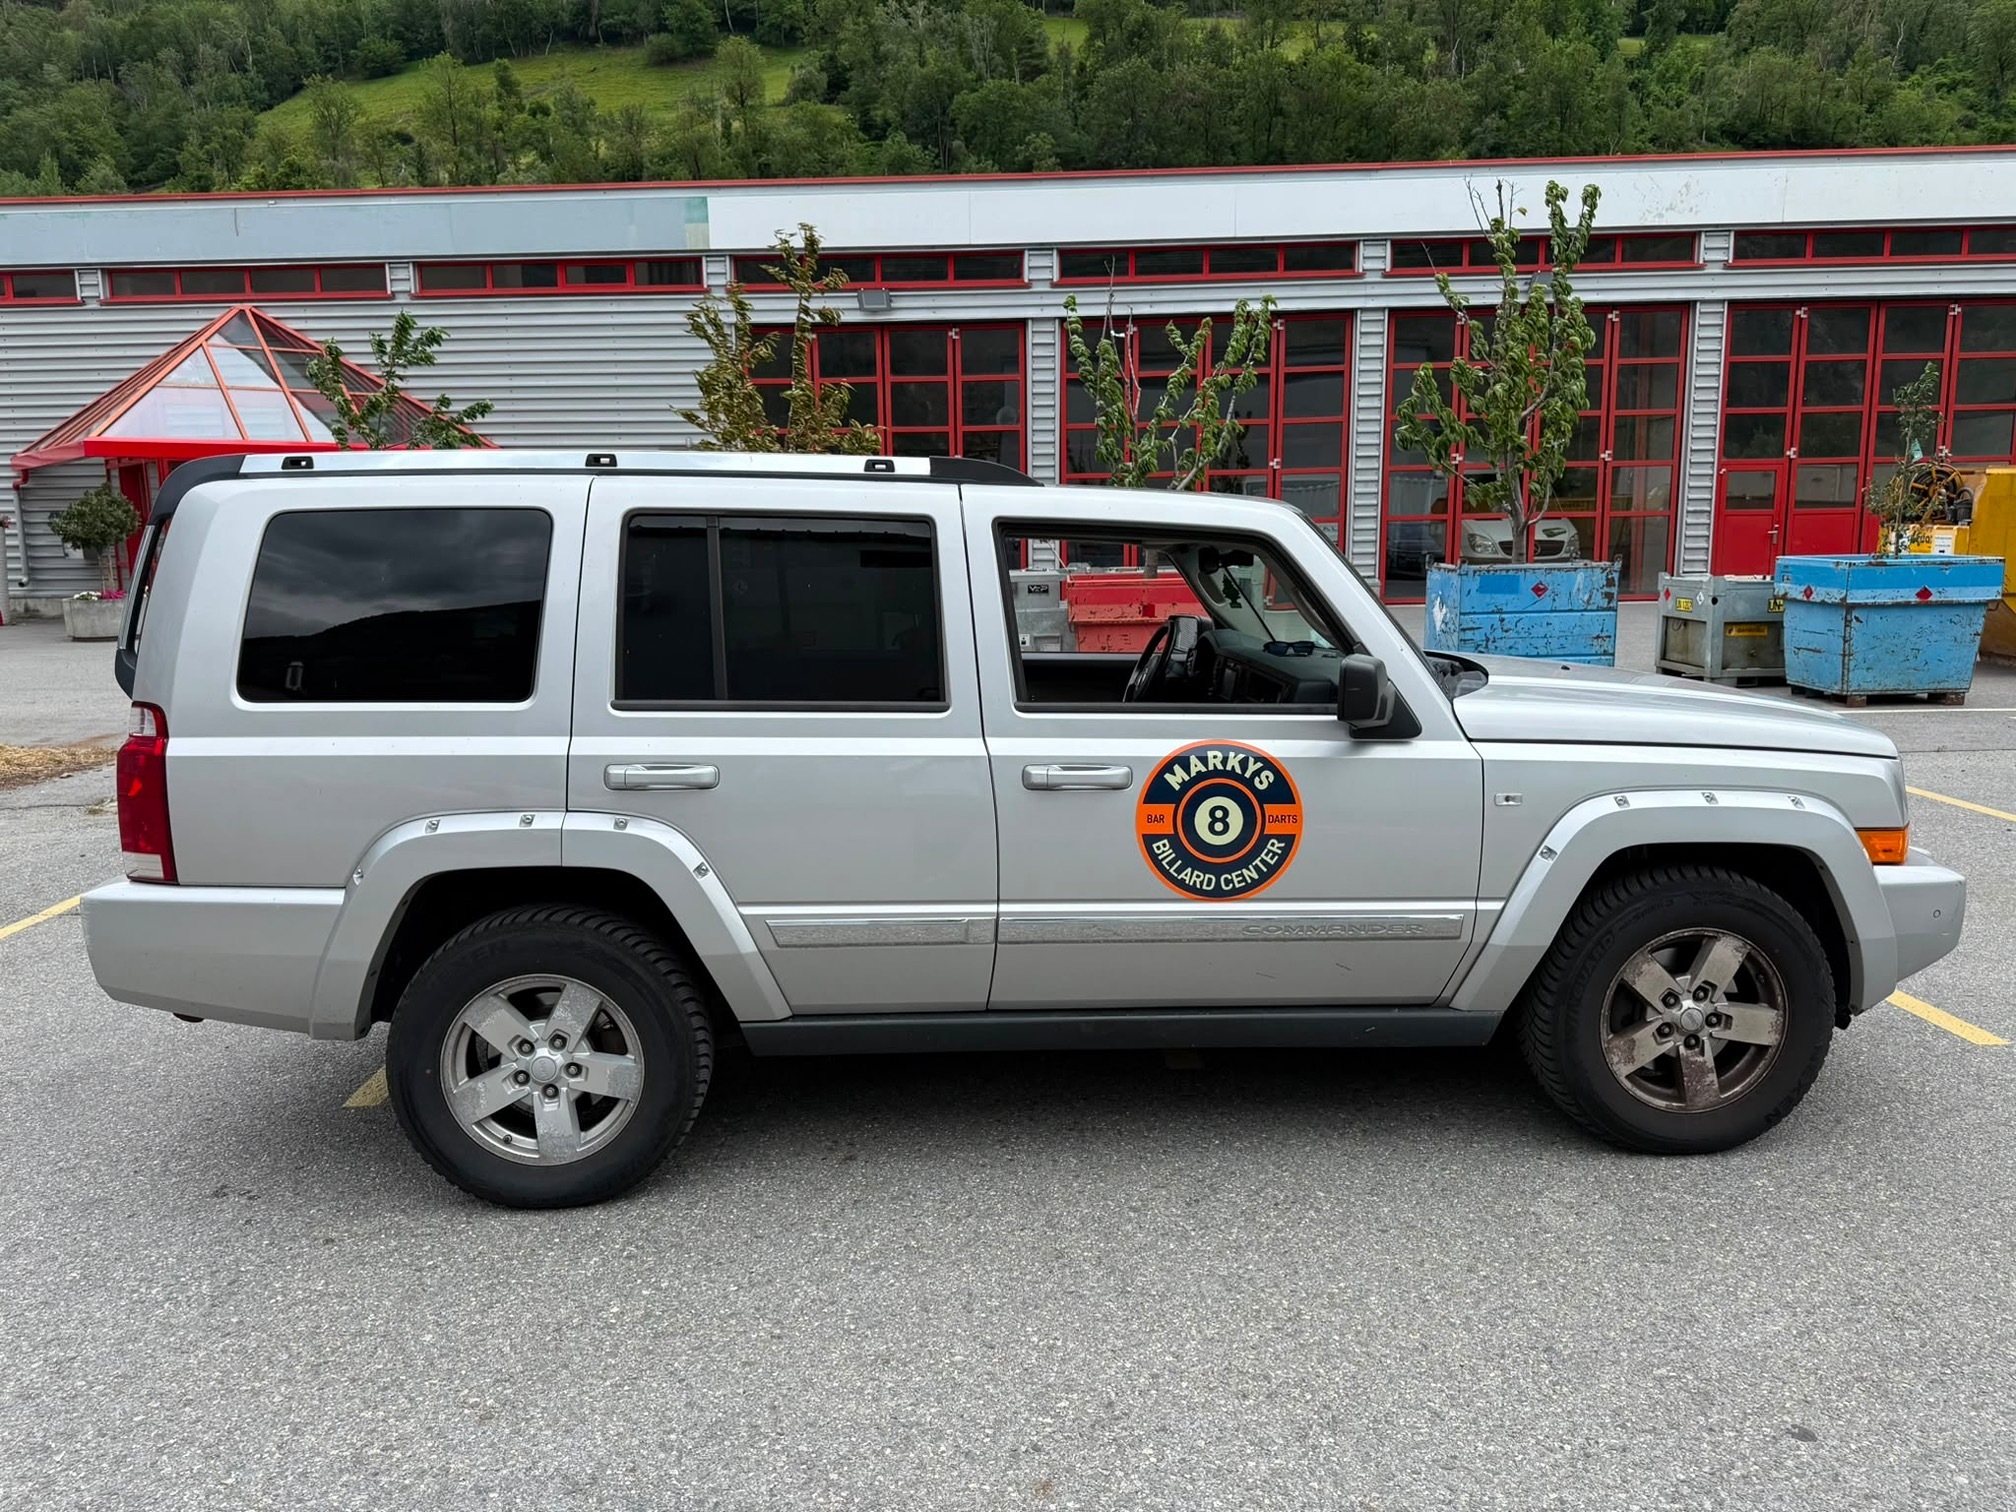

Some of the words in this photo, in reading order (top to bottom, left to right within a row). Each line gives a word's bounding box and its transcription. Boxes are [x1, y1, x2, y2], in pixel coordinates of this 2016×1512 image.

[1163, 750, 1275, 791] MARKYS
[1146, 814, 1165, 824] BAR
[1207, 805, 1230, 836] 8
[1267, 814, 1298, 824] DARTS
[1152, 838, 1216, 891] BILLARD
[1220, 838, 1286, 891] CENTER
[1242, 924, 1424, 936] COMMANDER
